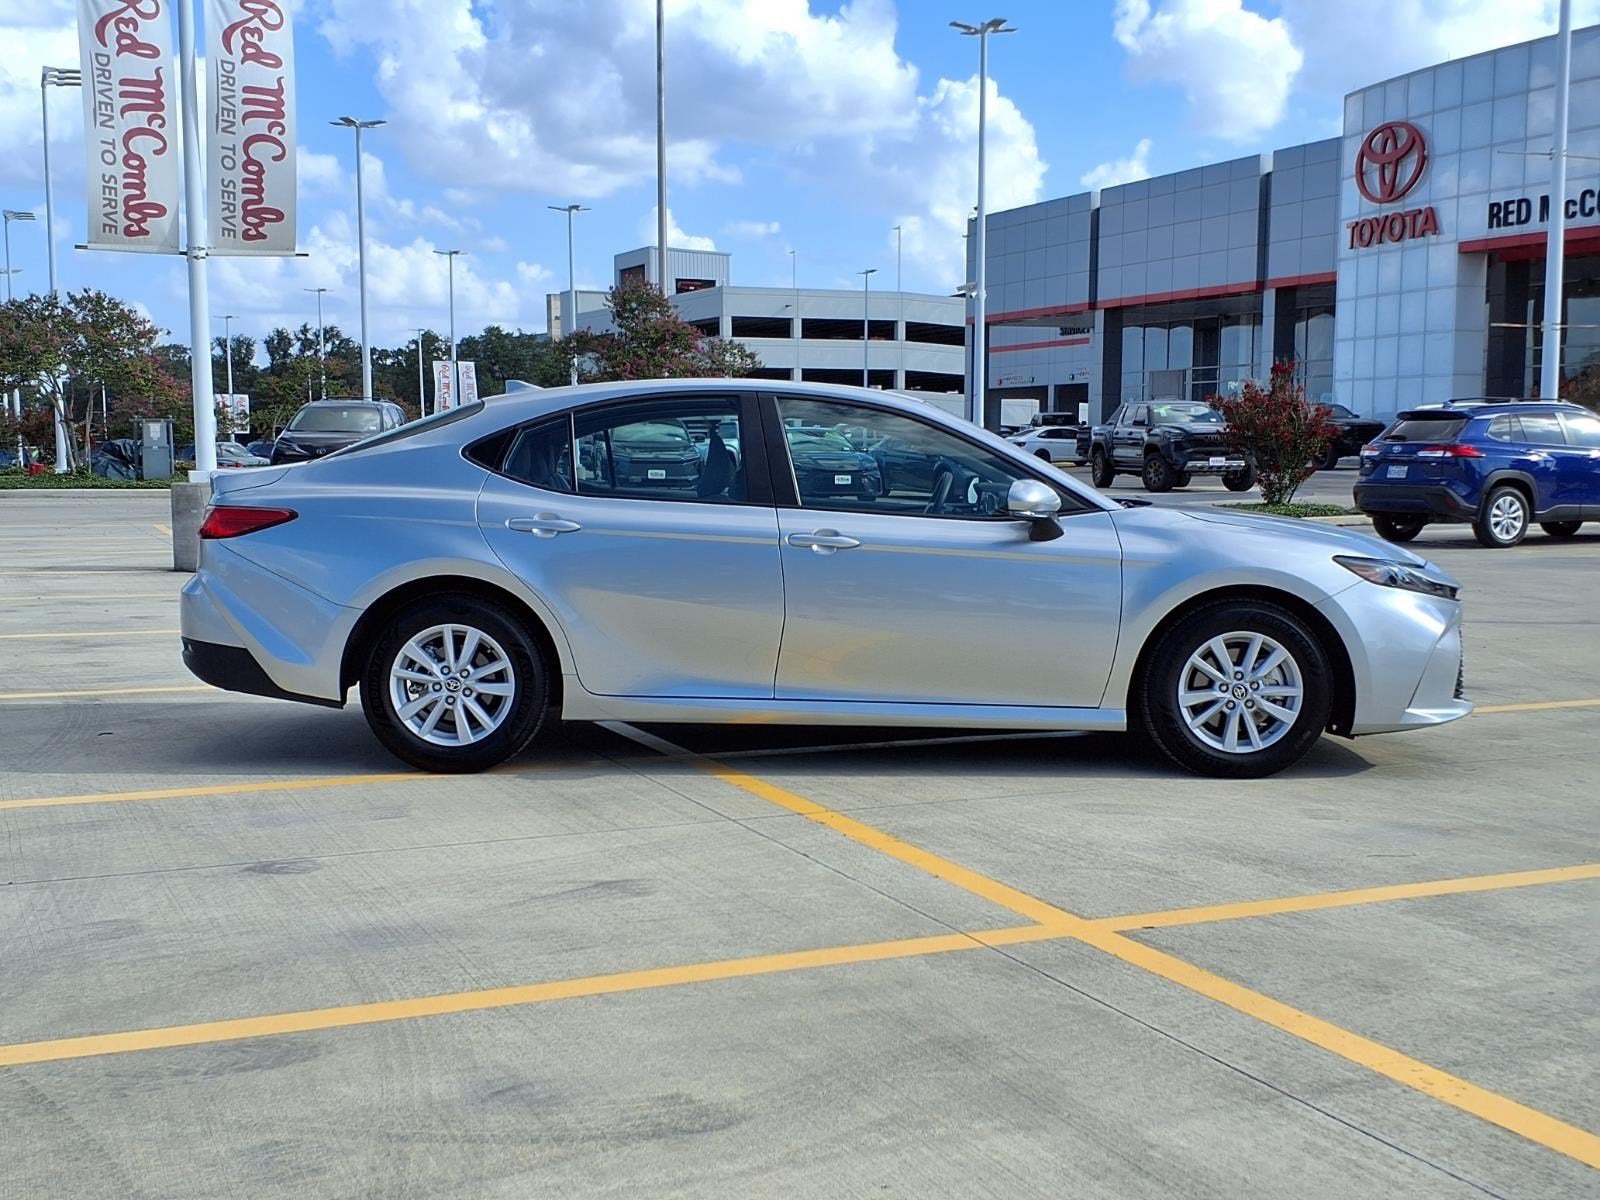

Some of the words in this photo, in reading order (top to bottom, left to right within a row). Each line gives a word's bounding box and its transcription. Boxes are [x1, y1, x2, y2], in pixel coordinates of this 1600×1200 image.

[95, 0, 161, 60] Red
[221, 0, 285, 69] Red
[94, 52, 116, 129] DRIVEN
[220, 59, 236, 135] DRIVEN
[99, 138, 117, 166] TO
[118, 66, 168, 238] McCombs
[220, 144, 236, 171] TO
[241, 76, 287, 242] McCombs
[101, 173, 118, 235] SERVE
[220, 178, 236, 239] SERVE
[1346, 206, 1439, 250] TOYOTA
[1488, 197, 1532, 229] RED
[1539, 189, 1600, 223] cC
